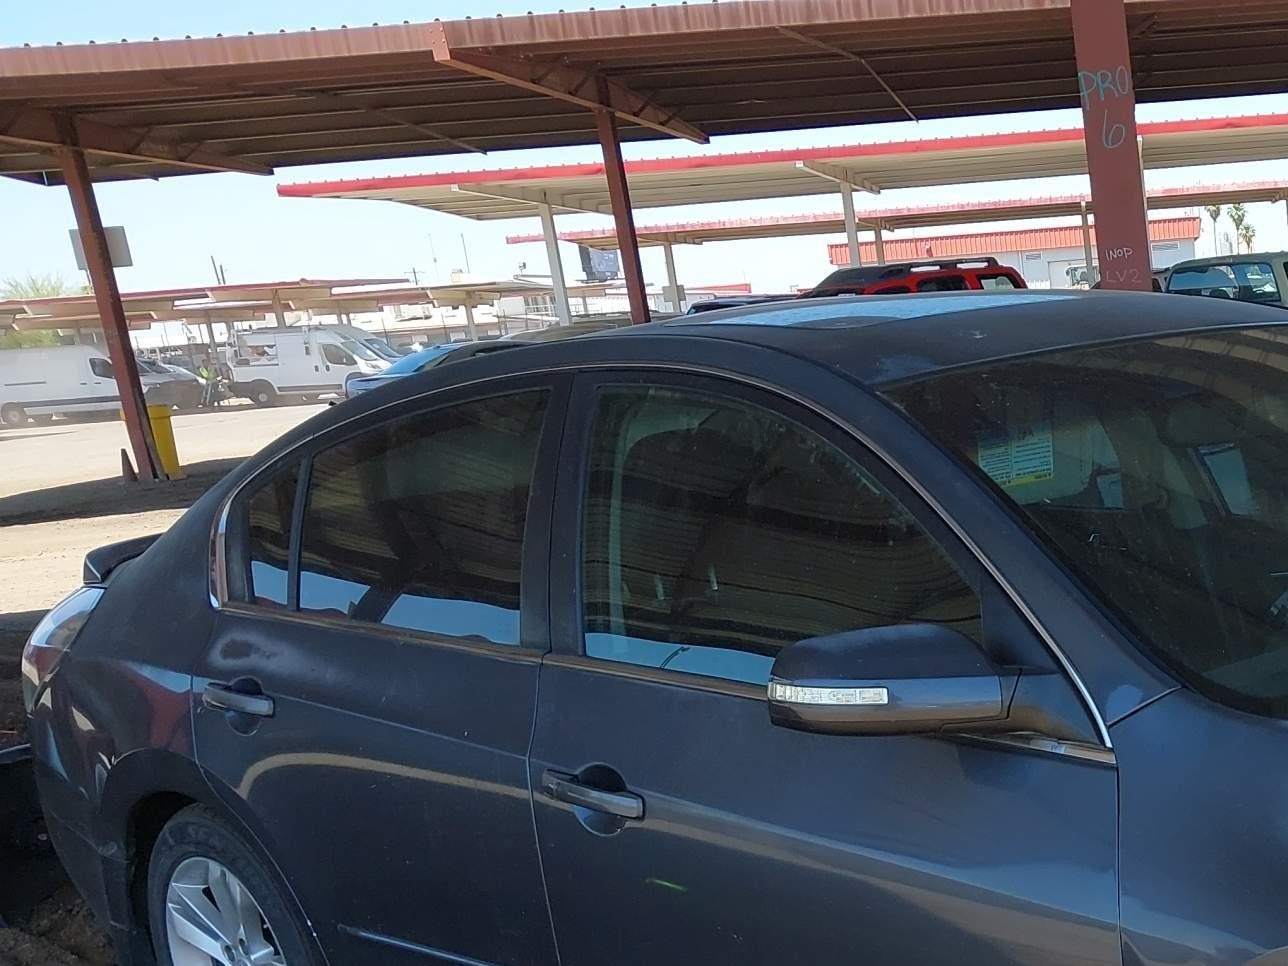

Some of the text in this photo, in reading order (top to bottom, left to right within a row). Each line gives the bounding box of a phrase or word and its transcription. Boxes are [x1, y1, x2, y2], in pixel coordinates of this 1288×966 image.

[1078, 65, 1131, 109] PRO
[1102, 109, 1127, 149] 6
[1105, 247, 1134, 261] INOP
